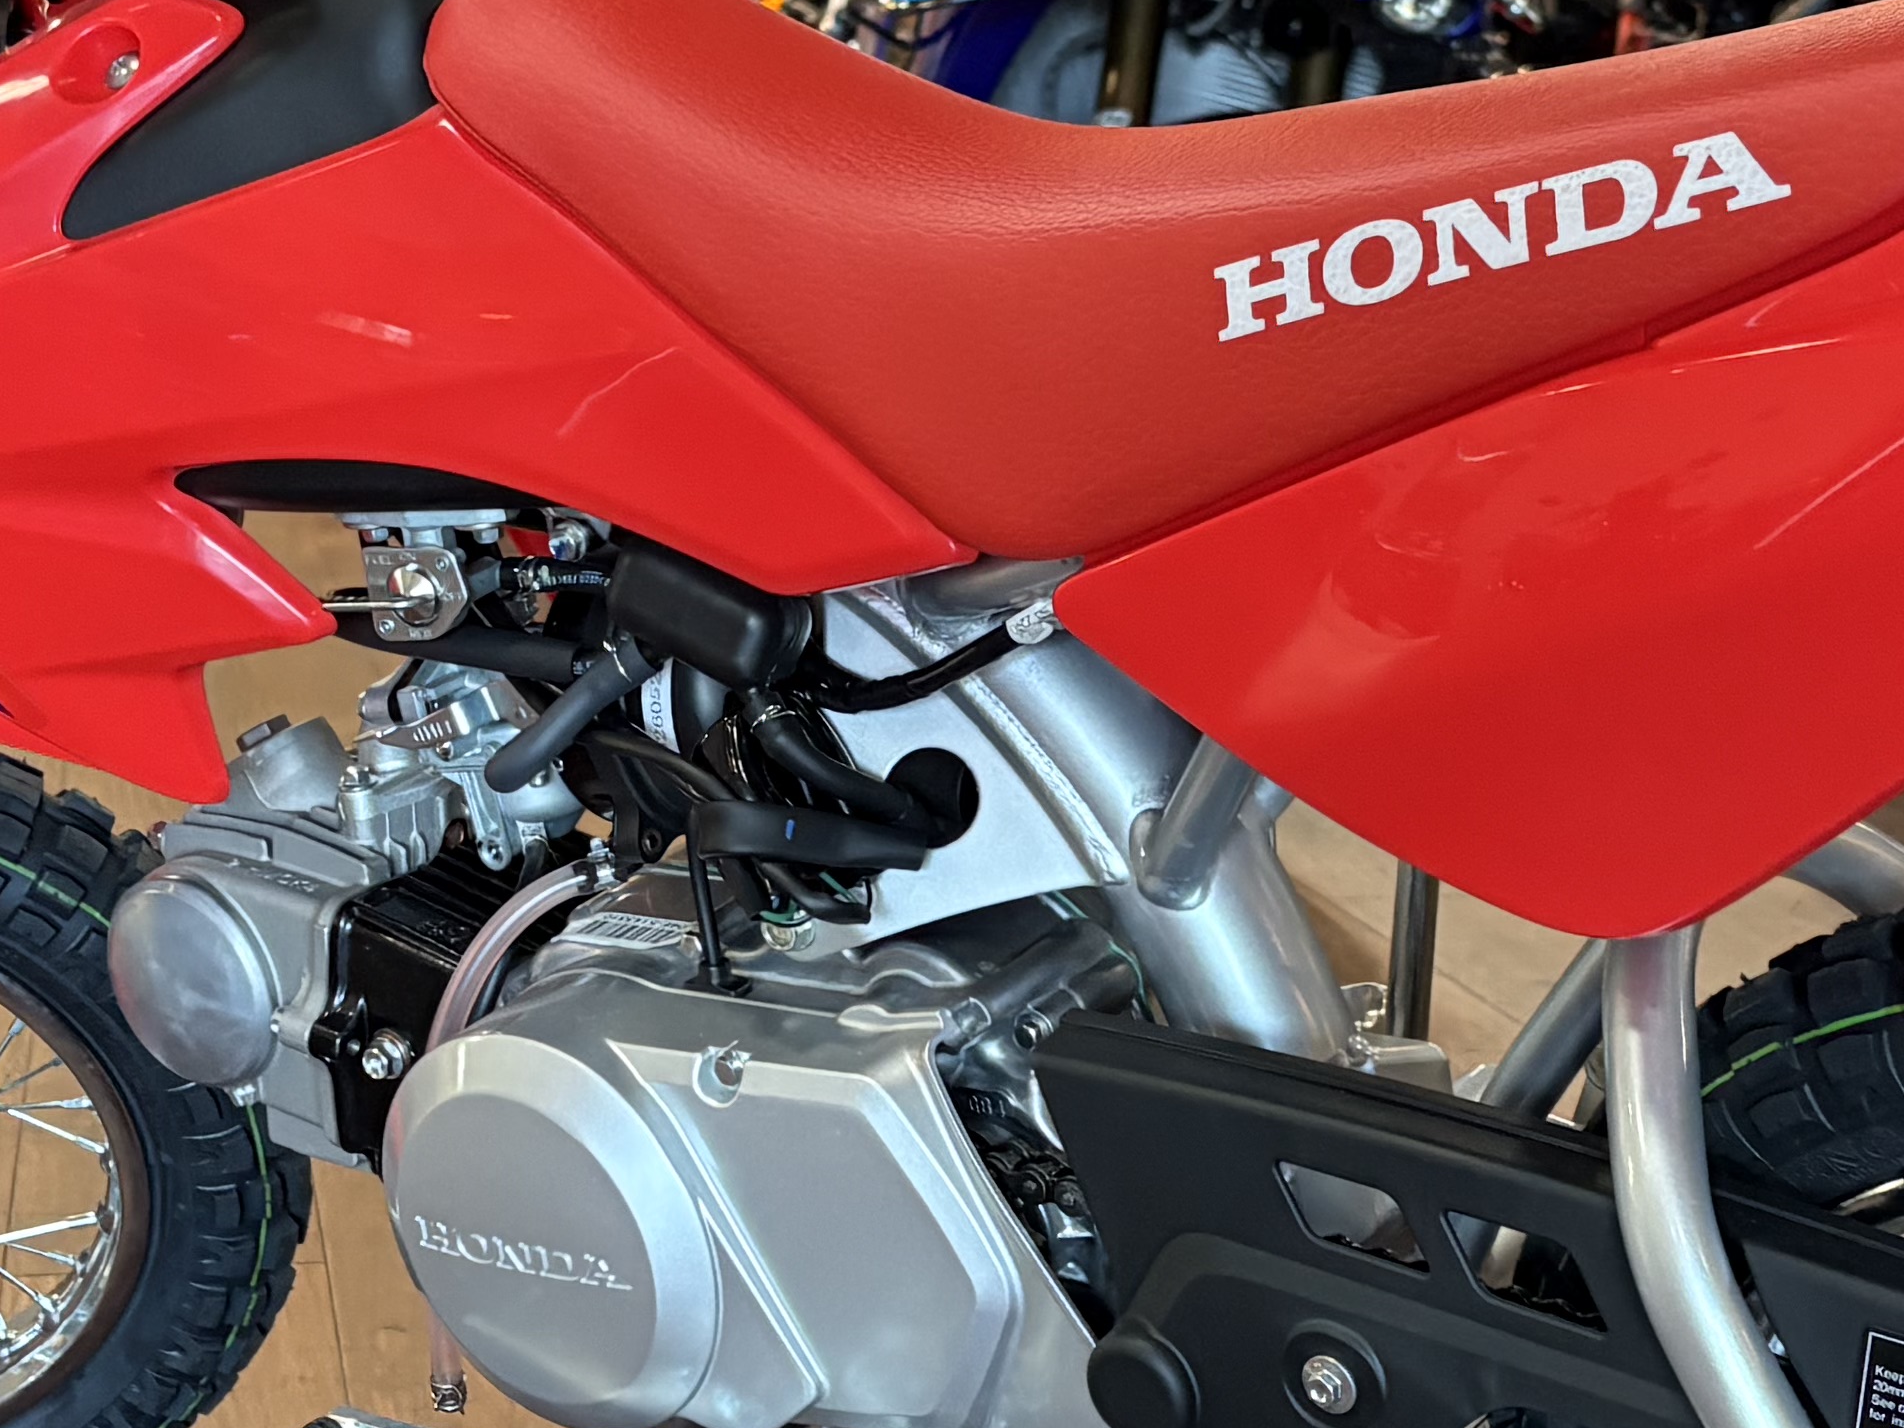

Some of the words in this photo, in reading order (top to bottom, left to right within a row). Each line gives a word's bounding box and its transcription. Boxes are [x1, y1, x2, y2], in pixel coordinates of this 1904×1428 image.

[1212, 130, 1792, 343] HONDA
[414, 1215, 634, 1291] HONDA
[1869, 1407, 1886, 1423] for
[1871, 1393, 1896, 1411] See
